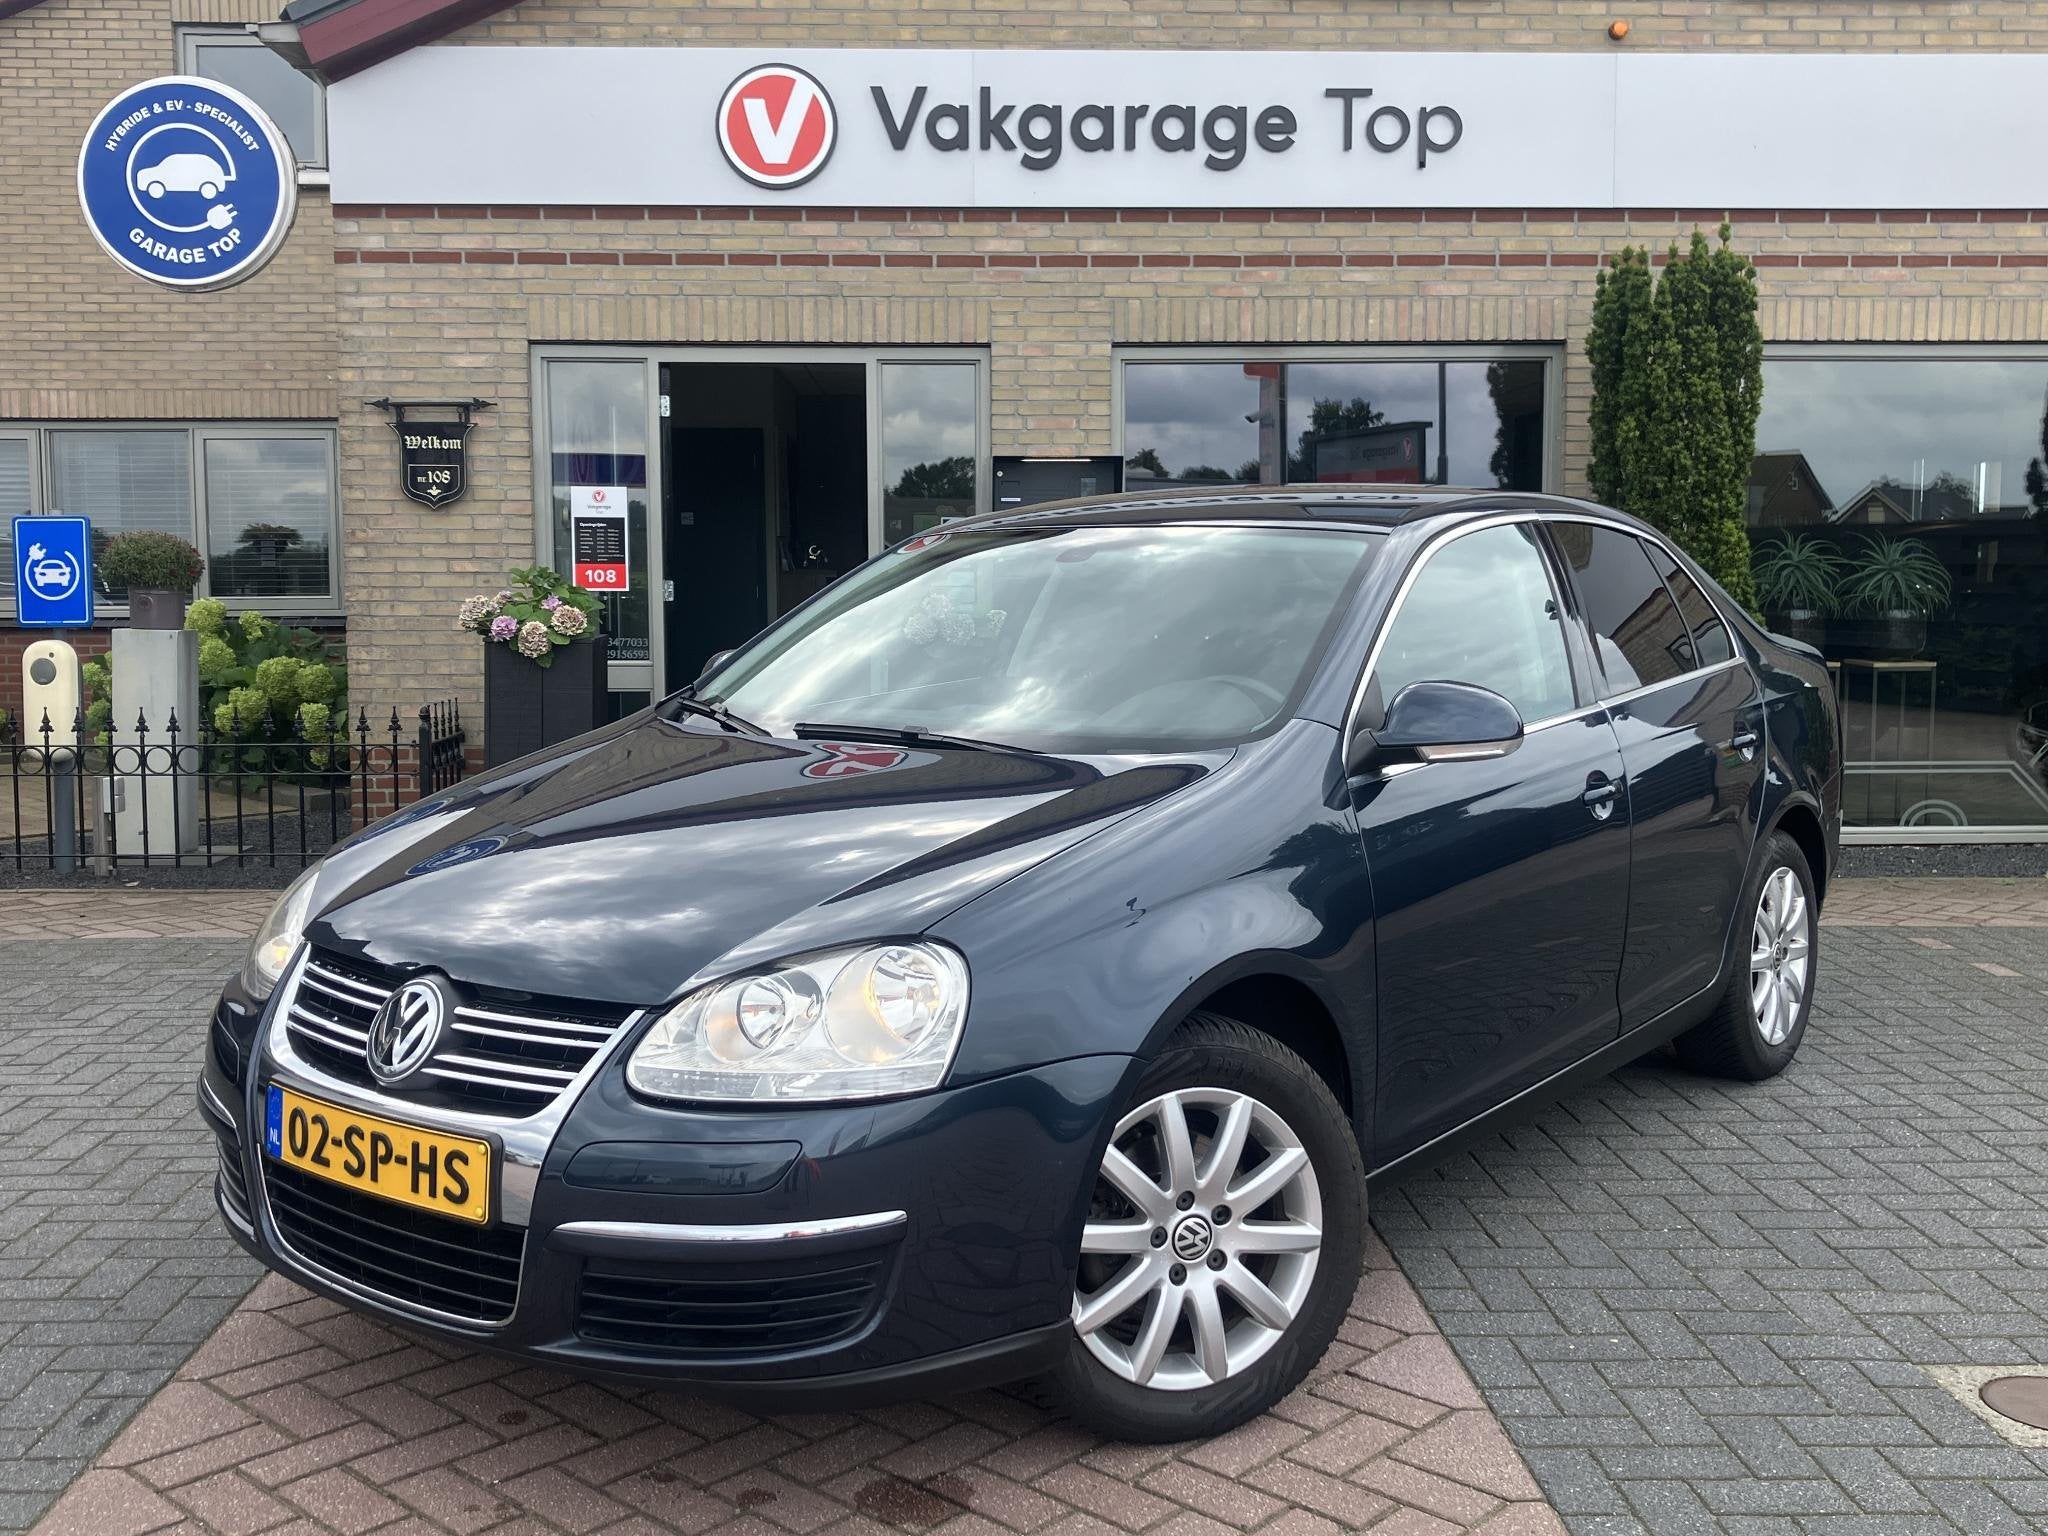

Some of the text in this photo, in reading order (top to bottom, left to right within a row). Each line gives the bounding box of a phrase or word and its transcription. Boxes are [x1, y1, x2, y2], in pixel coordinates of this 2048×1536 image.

[105, 107, 151, 152] HYBRIDE
[152, 102, 163, 114] &
[166, 100, 183, 111] EV
[194, 102, 260, 151] SPECIALIST
[869, 85, 1463, 171] Vakgarage Top
[129, 228, 241, 263] GARAGE TOP
[404, 435, 462, 449] Welkom
[585, 569, 617, 583] 108
[269, 1126, 280, 1146] NL
[288, 1106, 470, 1205] 02-SP-HS
